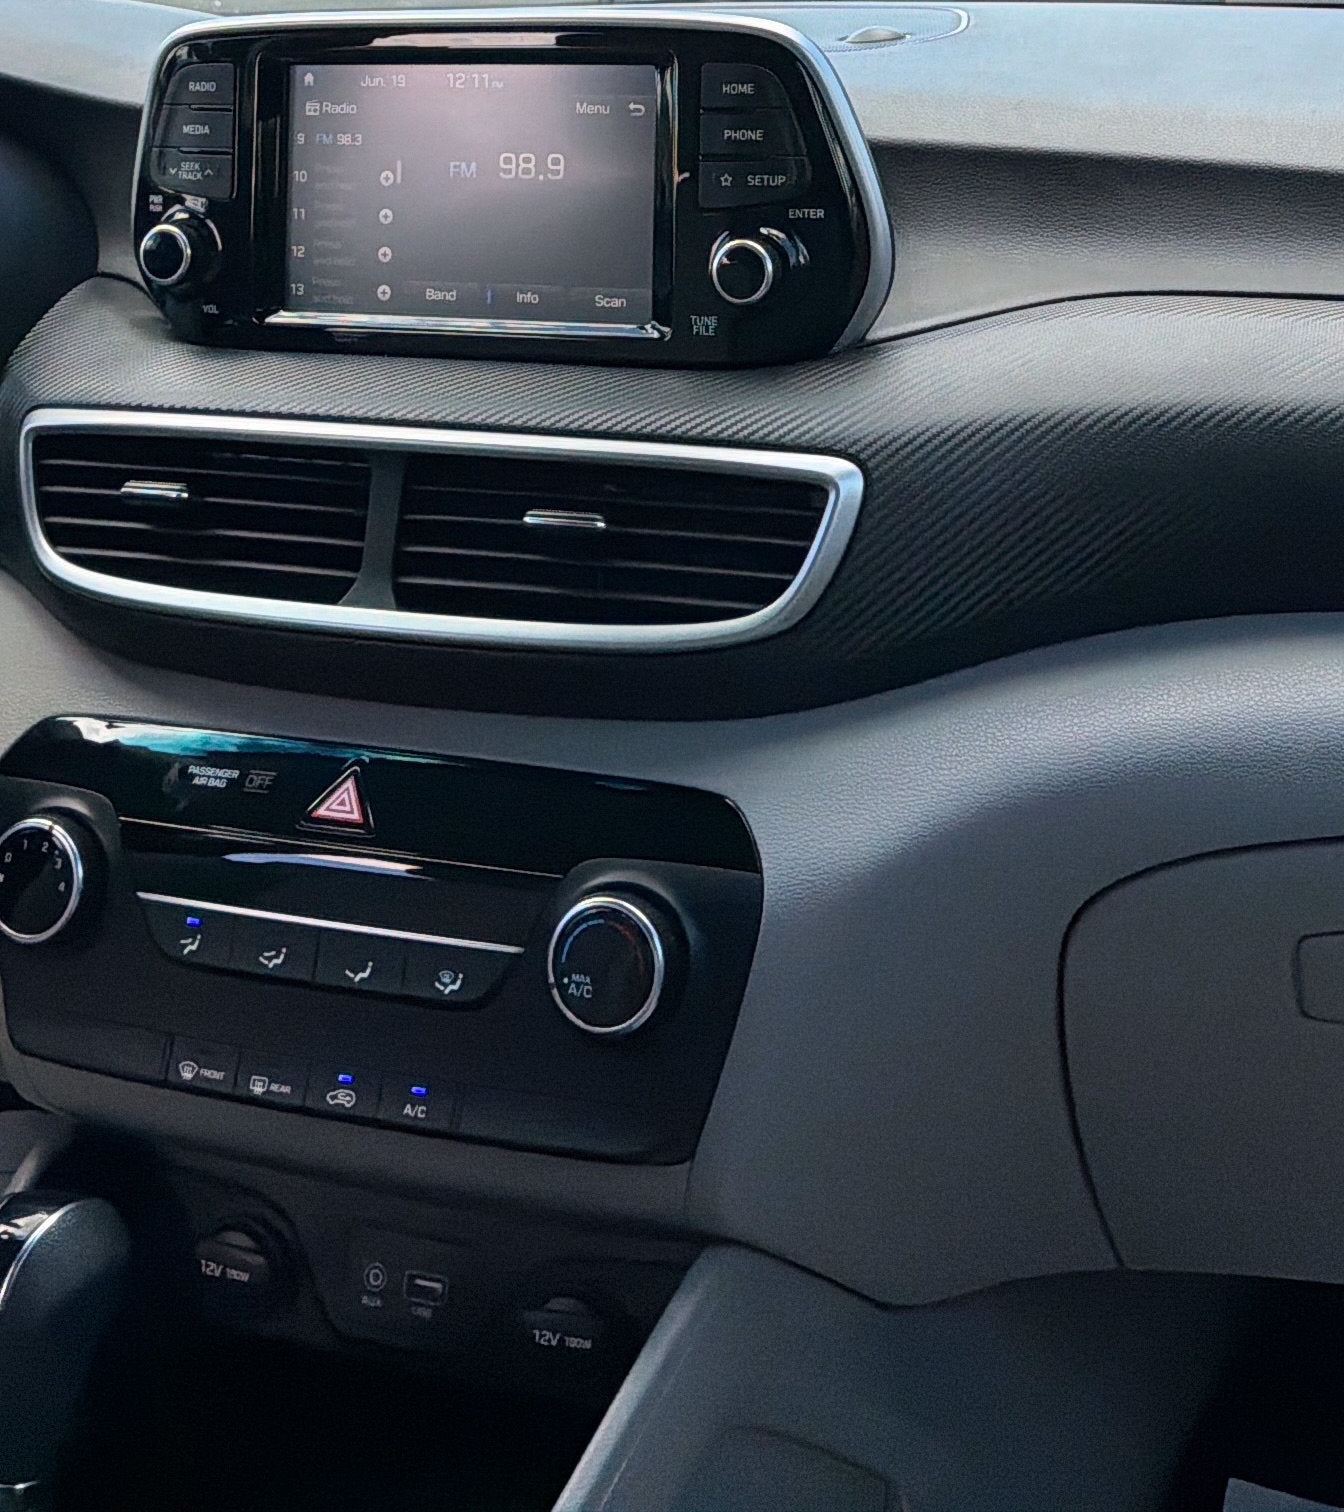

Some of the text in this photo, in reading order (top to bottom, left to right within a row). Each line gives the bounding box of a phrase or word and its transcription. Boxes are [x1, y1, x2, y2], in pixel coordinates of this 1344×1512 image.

[188, 81, 216, 92] RADIO
[391, 74, 407, 87] 19
[722, 83, 755, 95] HOME
[322, 102, 357, 115] Radio
[575, 102, 610, 115] Menu
[182, 124, 210, 135] MEDIA
[724, 129, 765, 141] PHONE
[296, 133, 363, 146] 9 FM 98.3
[180, 161, 201, 171] SEEK
[449, 152, 565, 182] FM 98.9
[177, 170, 203, 180] TRACK
[293, 170, 308, 183] 10
[747, 175, 787, 186] SETUP
[292, 207, 306, 221] 11
[788, 208, 825, 219] ENTER
[291, 245, 306, 258] 12
[290, 283, 305, 296] 13
[425, 289, 457, 301] Band
[516, 291, 540, 304] Info
[594, 294, 627, 308] Scan
[202, 304, 219, 314] VOL
[690, 315, 718, 326] TUNE
[692, 325, 716, 336] FILE
[187, 764, 240, 779] PASSENGER
[245, 774, 275, 789] OFF
[41, 840, 49, 853] 2
[568, 983, 593, 999] A/C
[199, 1067, 226, 1081] FRONT
[269, 1082, 292, 1095] REAR
[403, 1104, 427, 1119] A/C
[200, 1259, 223, 1278] 12V
[532, 1328, 560, 1347] 12V
